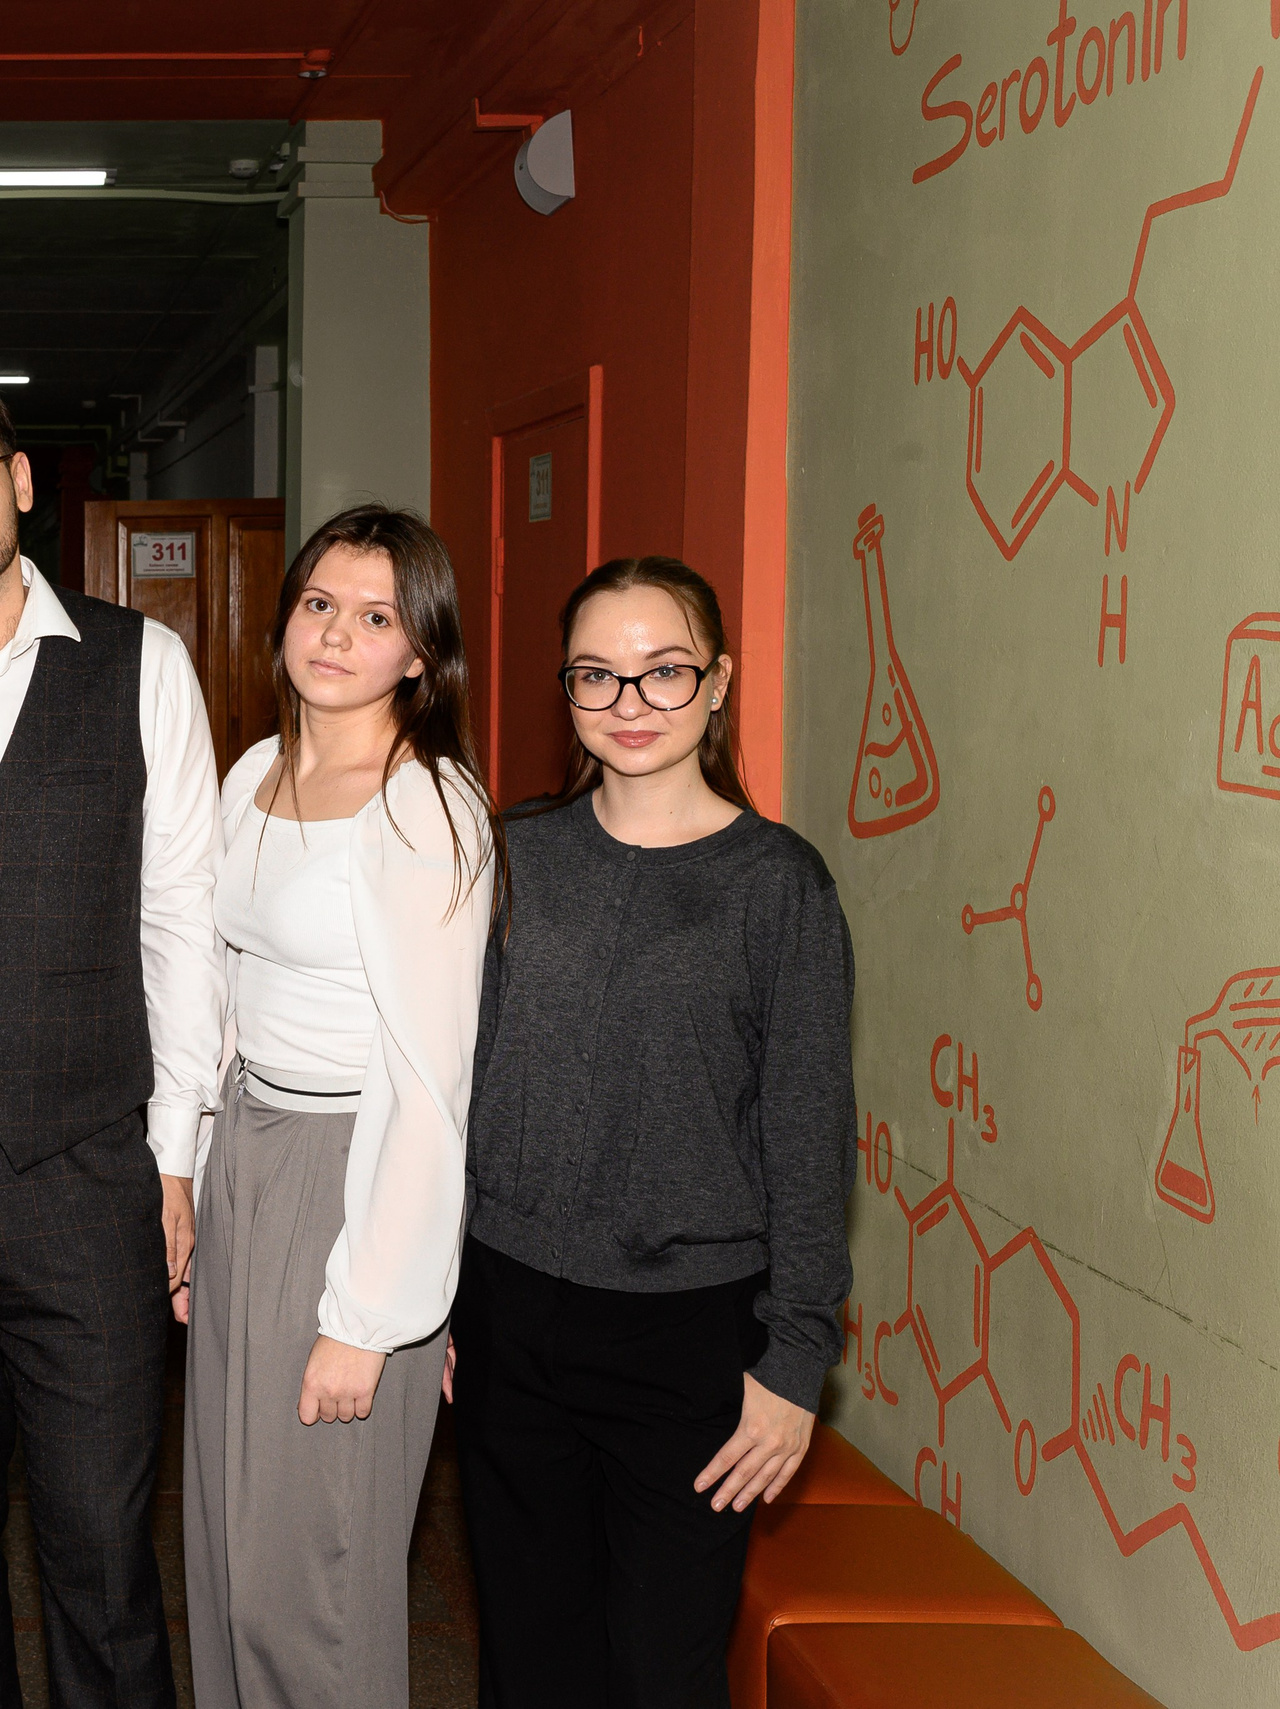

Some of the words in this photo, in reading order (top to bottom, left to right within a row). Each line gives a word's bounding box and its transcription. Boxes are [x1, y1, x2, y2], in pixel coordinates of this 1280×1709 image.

[912, 0, 1188, 184] Serotonin
[914, 296, 958, 385] HO
[151, 542, 187, 561] 311
[1104, 480, 1131, 557] N
[1097, 574, 1128, 667] H
[914, 1446, 972, 1540] CH
